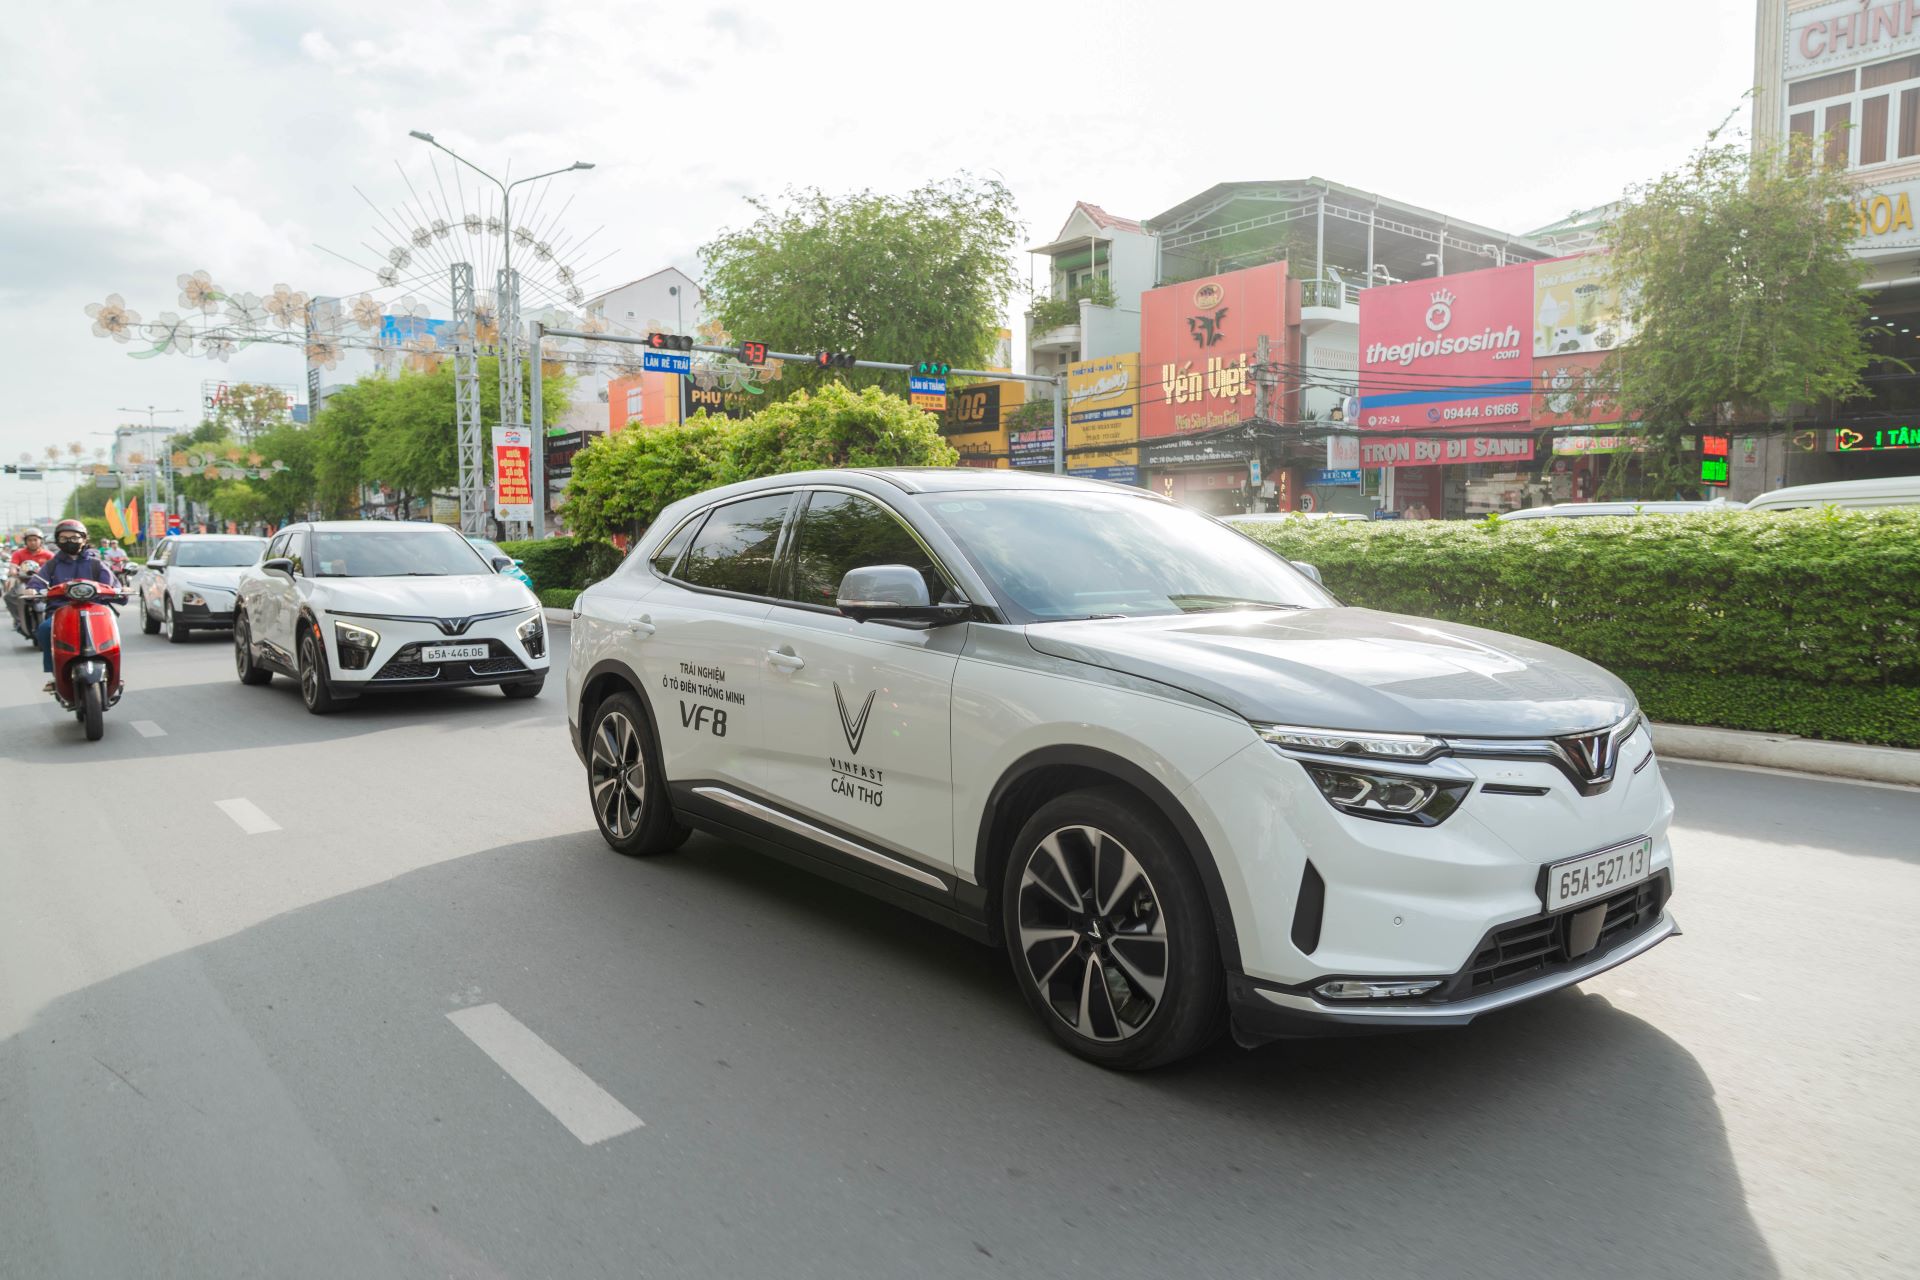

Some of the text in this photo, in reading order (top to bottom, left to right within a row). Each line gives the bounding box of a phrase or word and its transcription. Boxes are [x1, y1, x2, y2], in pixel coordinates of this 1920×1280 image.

[1366, 325, 1521, 367] thegioisosinh
[1492, 349, 1520, 361] .com
[645, 355, 659, 367] LÀN
[673, 359, 689, 370] TRÁI
[1162, 361, 1203, 405] Yến
[1208, 353, 1252, 404] Việt
[691, 390, 722, 408] PHỤ
[1361, 442, 1410, 464] TRỌN
[1447, 438, 1467, 458] ĐI
[1473, 437, 1528, 457] SANH
[428, 647, 484, 660] 65A-446.06
[697, 666, 726, 684] NGHIỆM
[697, 683, 724, 701] THÔNG
[725, 690, 745, 706] MINH
[679, 700, 728, 738] VF8
[829, 756, 883, 782] VINFAST
[831, 775, 884, 808] CẦN THƠ
[1560, 848, 1645, 900] 65A-527.13
